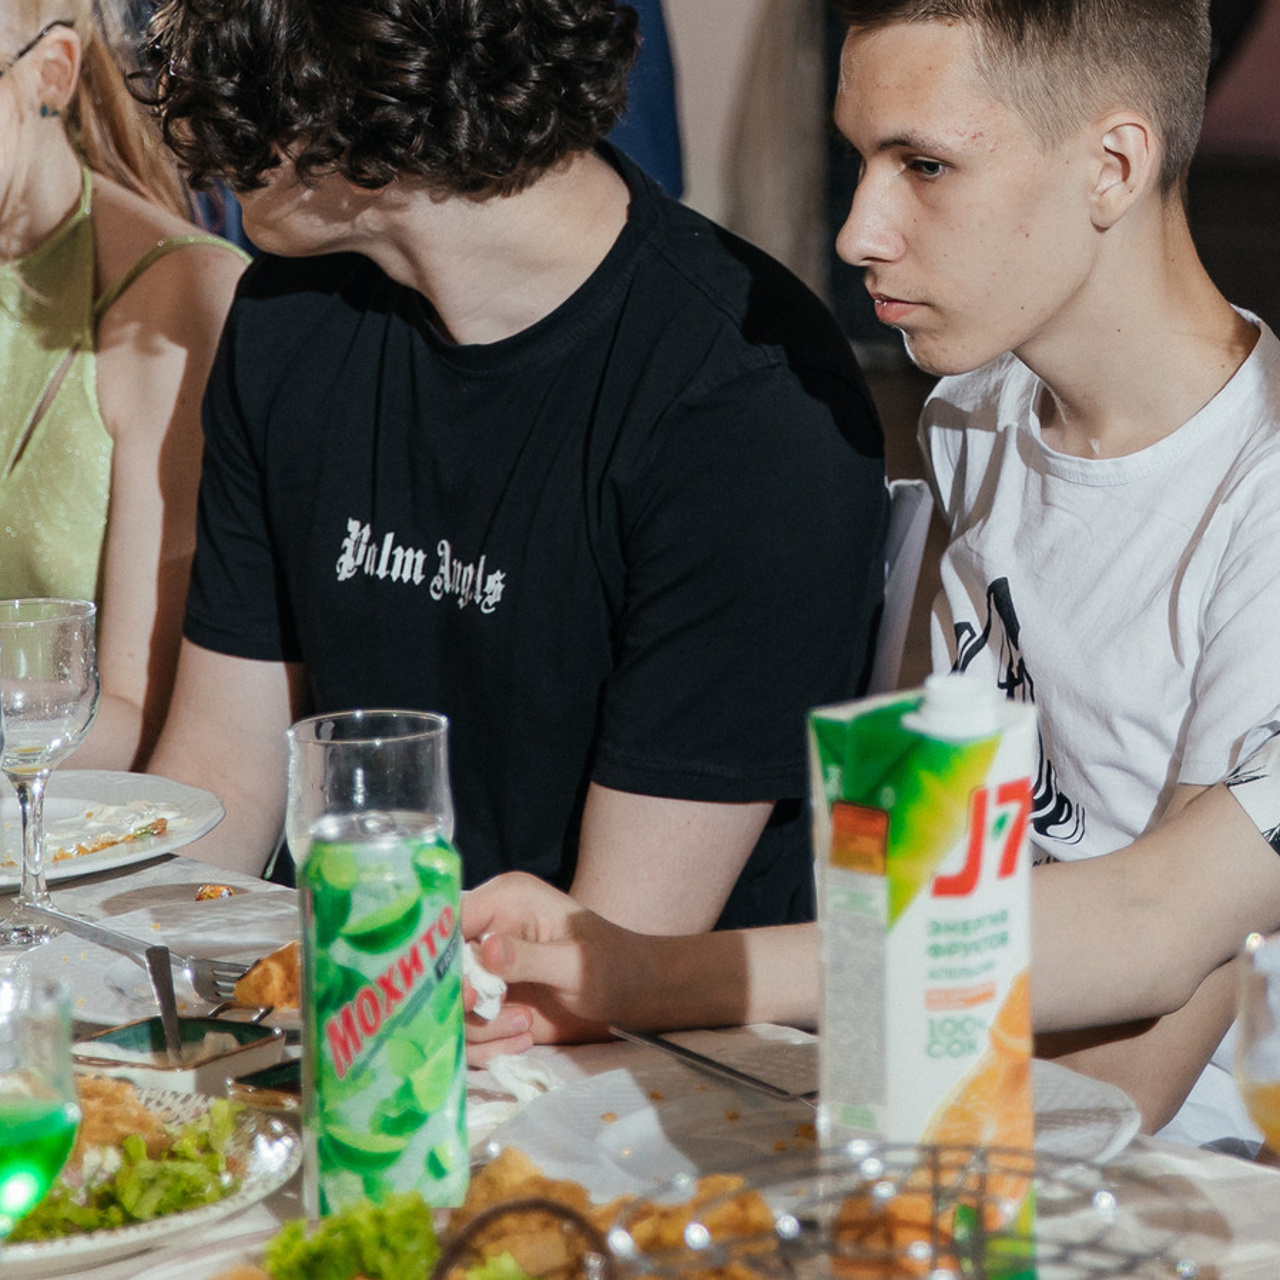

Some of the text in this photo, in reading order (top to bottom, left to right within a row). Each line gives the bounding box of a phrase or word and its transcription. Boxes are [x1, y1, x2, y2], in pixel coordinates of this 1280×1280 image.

[336, 517, 506, 613] Palm Angls
[931, 776, 1032, 898] J7
[326, 906, 454, 1078] МОХИТО
